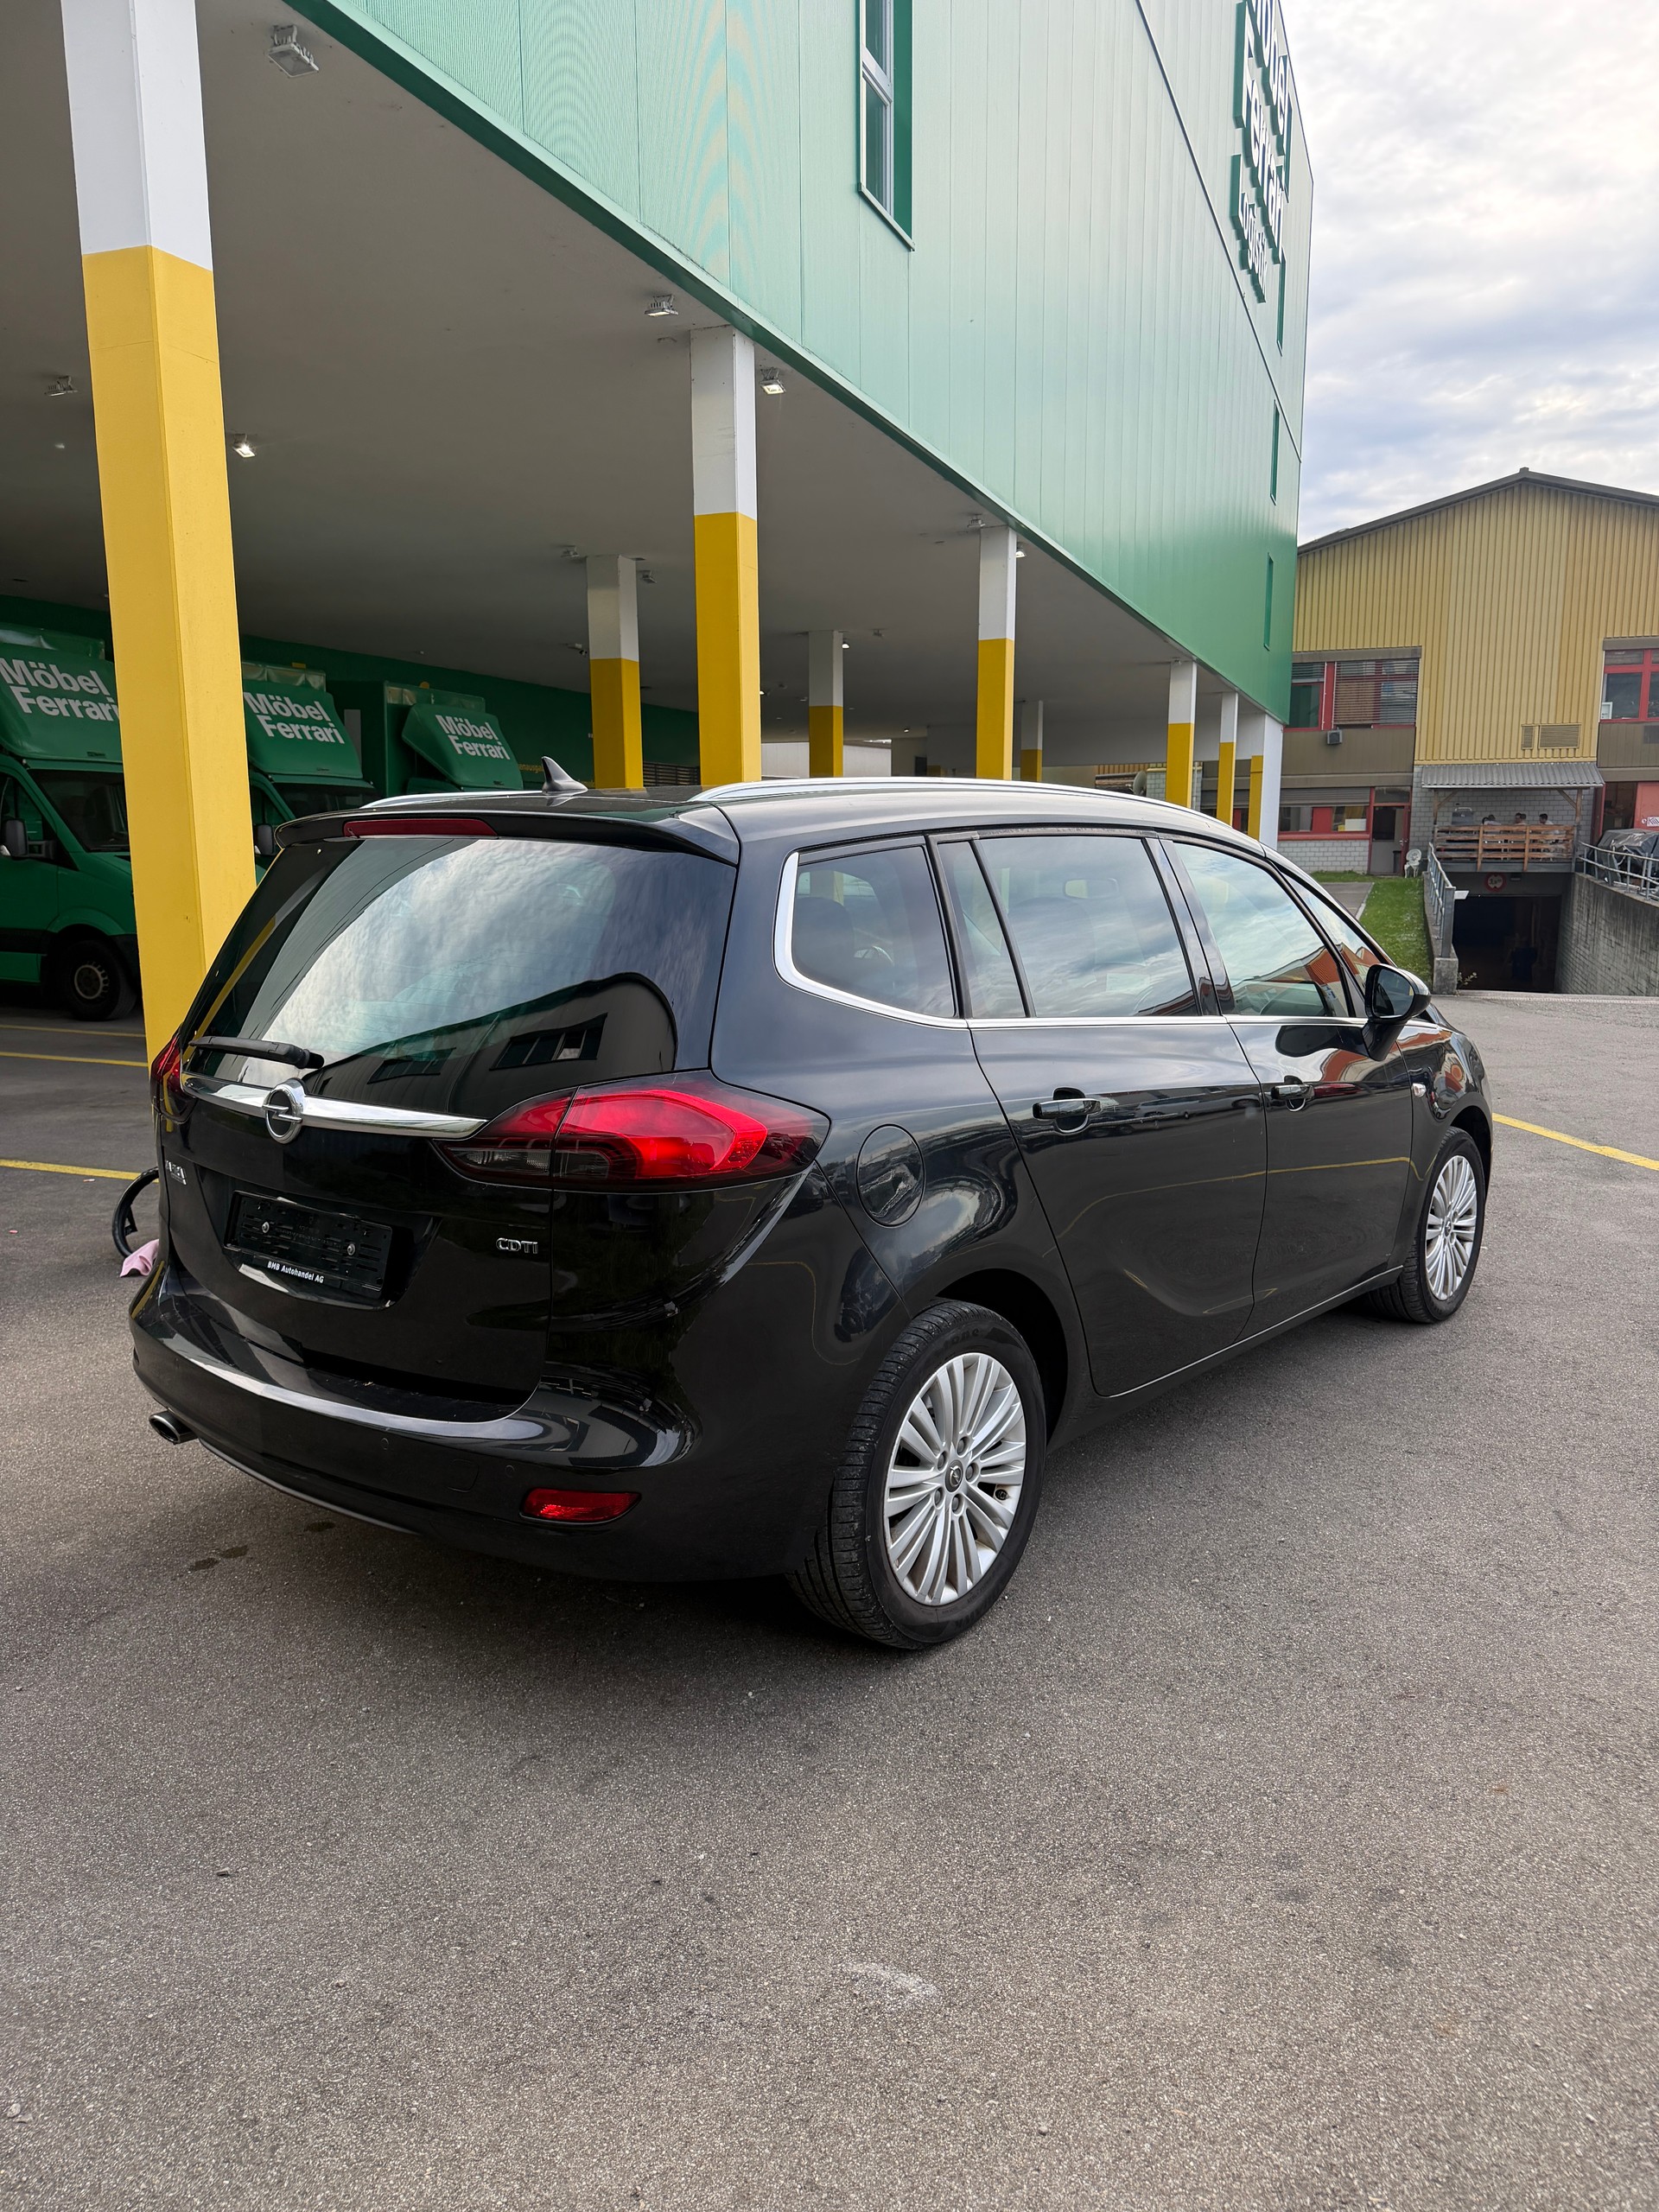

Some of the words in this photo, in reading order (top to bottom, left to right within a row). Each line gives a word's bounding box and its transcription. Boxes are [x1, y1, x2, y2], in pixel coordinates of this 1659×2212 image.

[1242, 2, 1285, 264] Ferrari
[1238, 155, 1268, 302] Logistik
[0, 658, 110, 696] Möbel
[243, 691, 331, 721] Möbel
[257, 715, 345, 744] Ferrari
[435, 715, 499, 741] Möbel
[448, 734, 510, 760] Ferrari
[267, 1261, 280, 1271] BMB
[281, 1265, 315, 1281] Autohandel
[315, 1274, 324, 1283] AG
